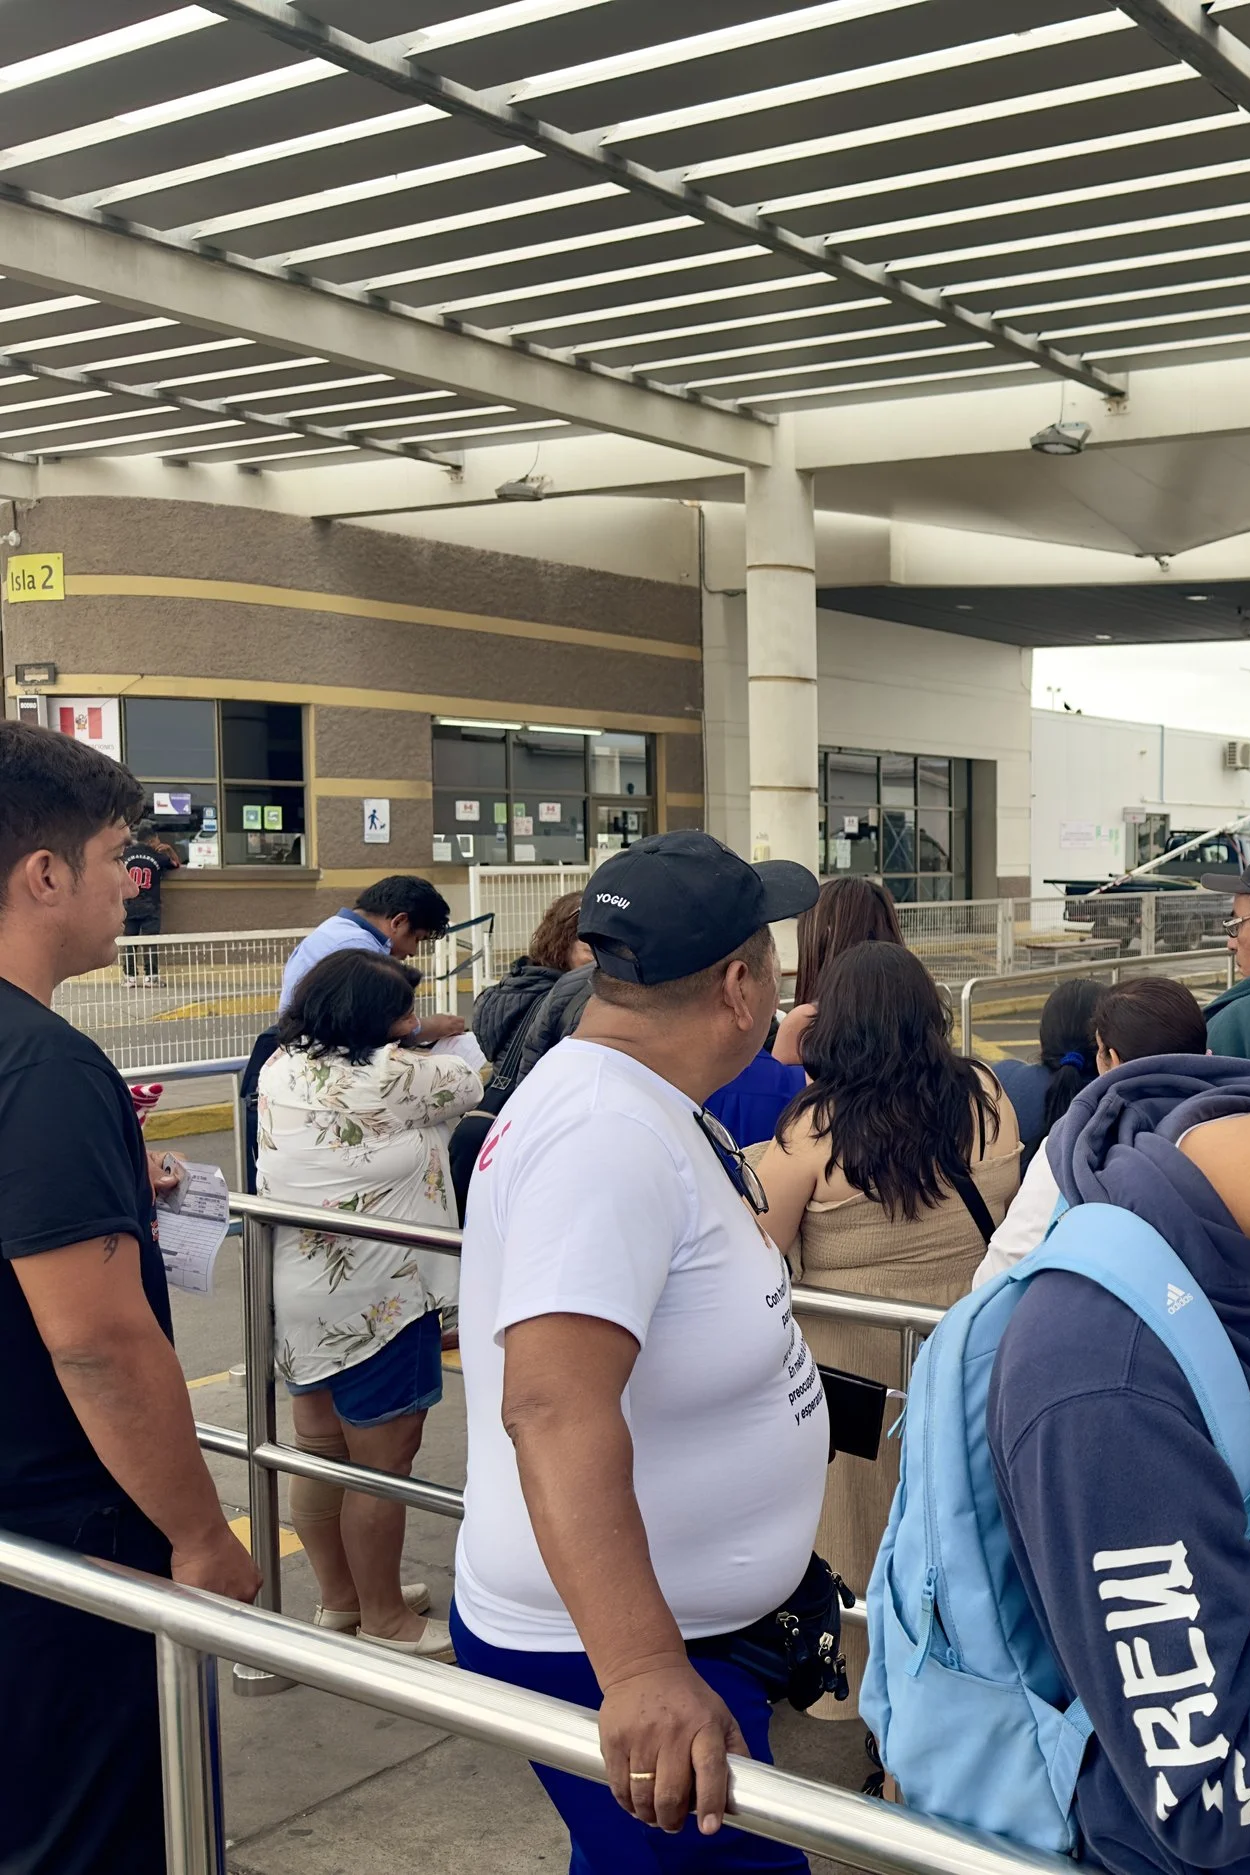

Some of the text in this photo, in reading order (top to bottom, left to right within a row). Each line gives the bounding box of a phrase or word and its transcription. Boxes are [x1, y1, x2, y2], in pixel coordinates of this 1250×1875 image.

[11, 565, 54, 591] Isla 2
[596, 893, 631, 910] YOGUI
[766, 1293, 781, 1308] Con
[795, 1412, 800, 1427] y
[1093, 1540, 1230, 1821] REW
